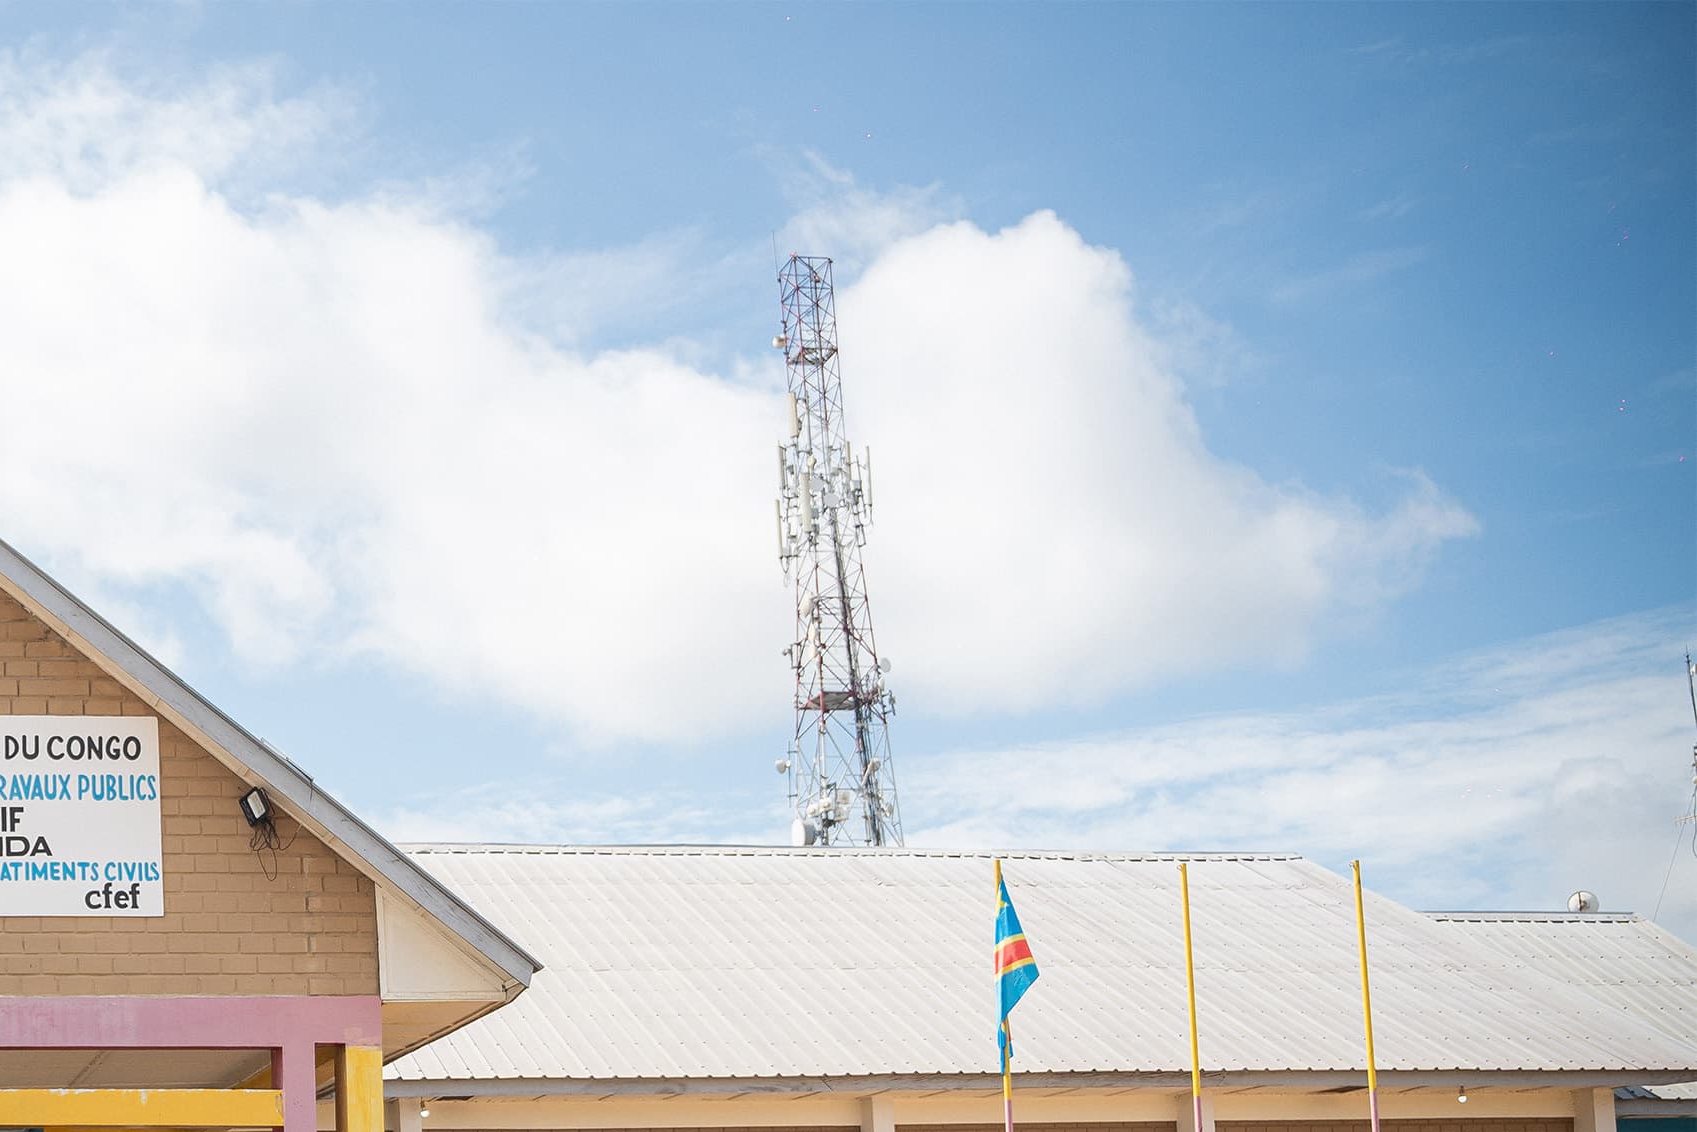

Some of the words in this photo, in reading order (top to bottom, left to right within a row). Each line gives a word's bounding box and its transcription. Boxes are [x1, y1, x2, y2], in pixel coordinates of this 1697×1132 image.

[5, 735, 42, 761] DU
[46, 735, 142, 761] CONGO
[77, 774, 157, 801] PUBLICS
[104, 861, 160, 882] CIVILS
[84, 882, 140, 910] cfef
